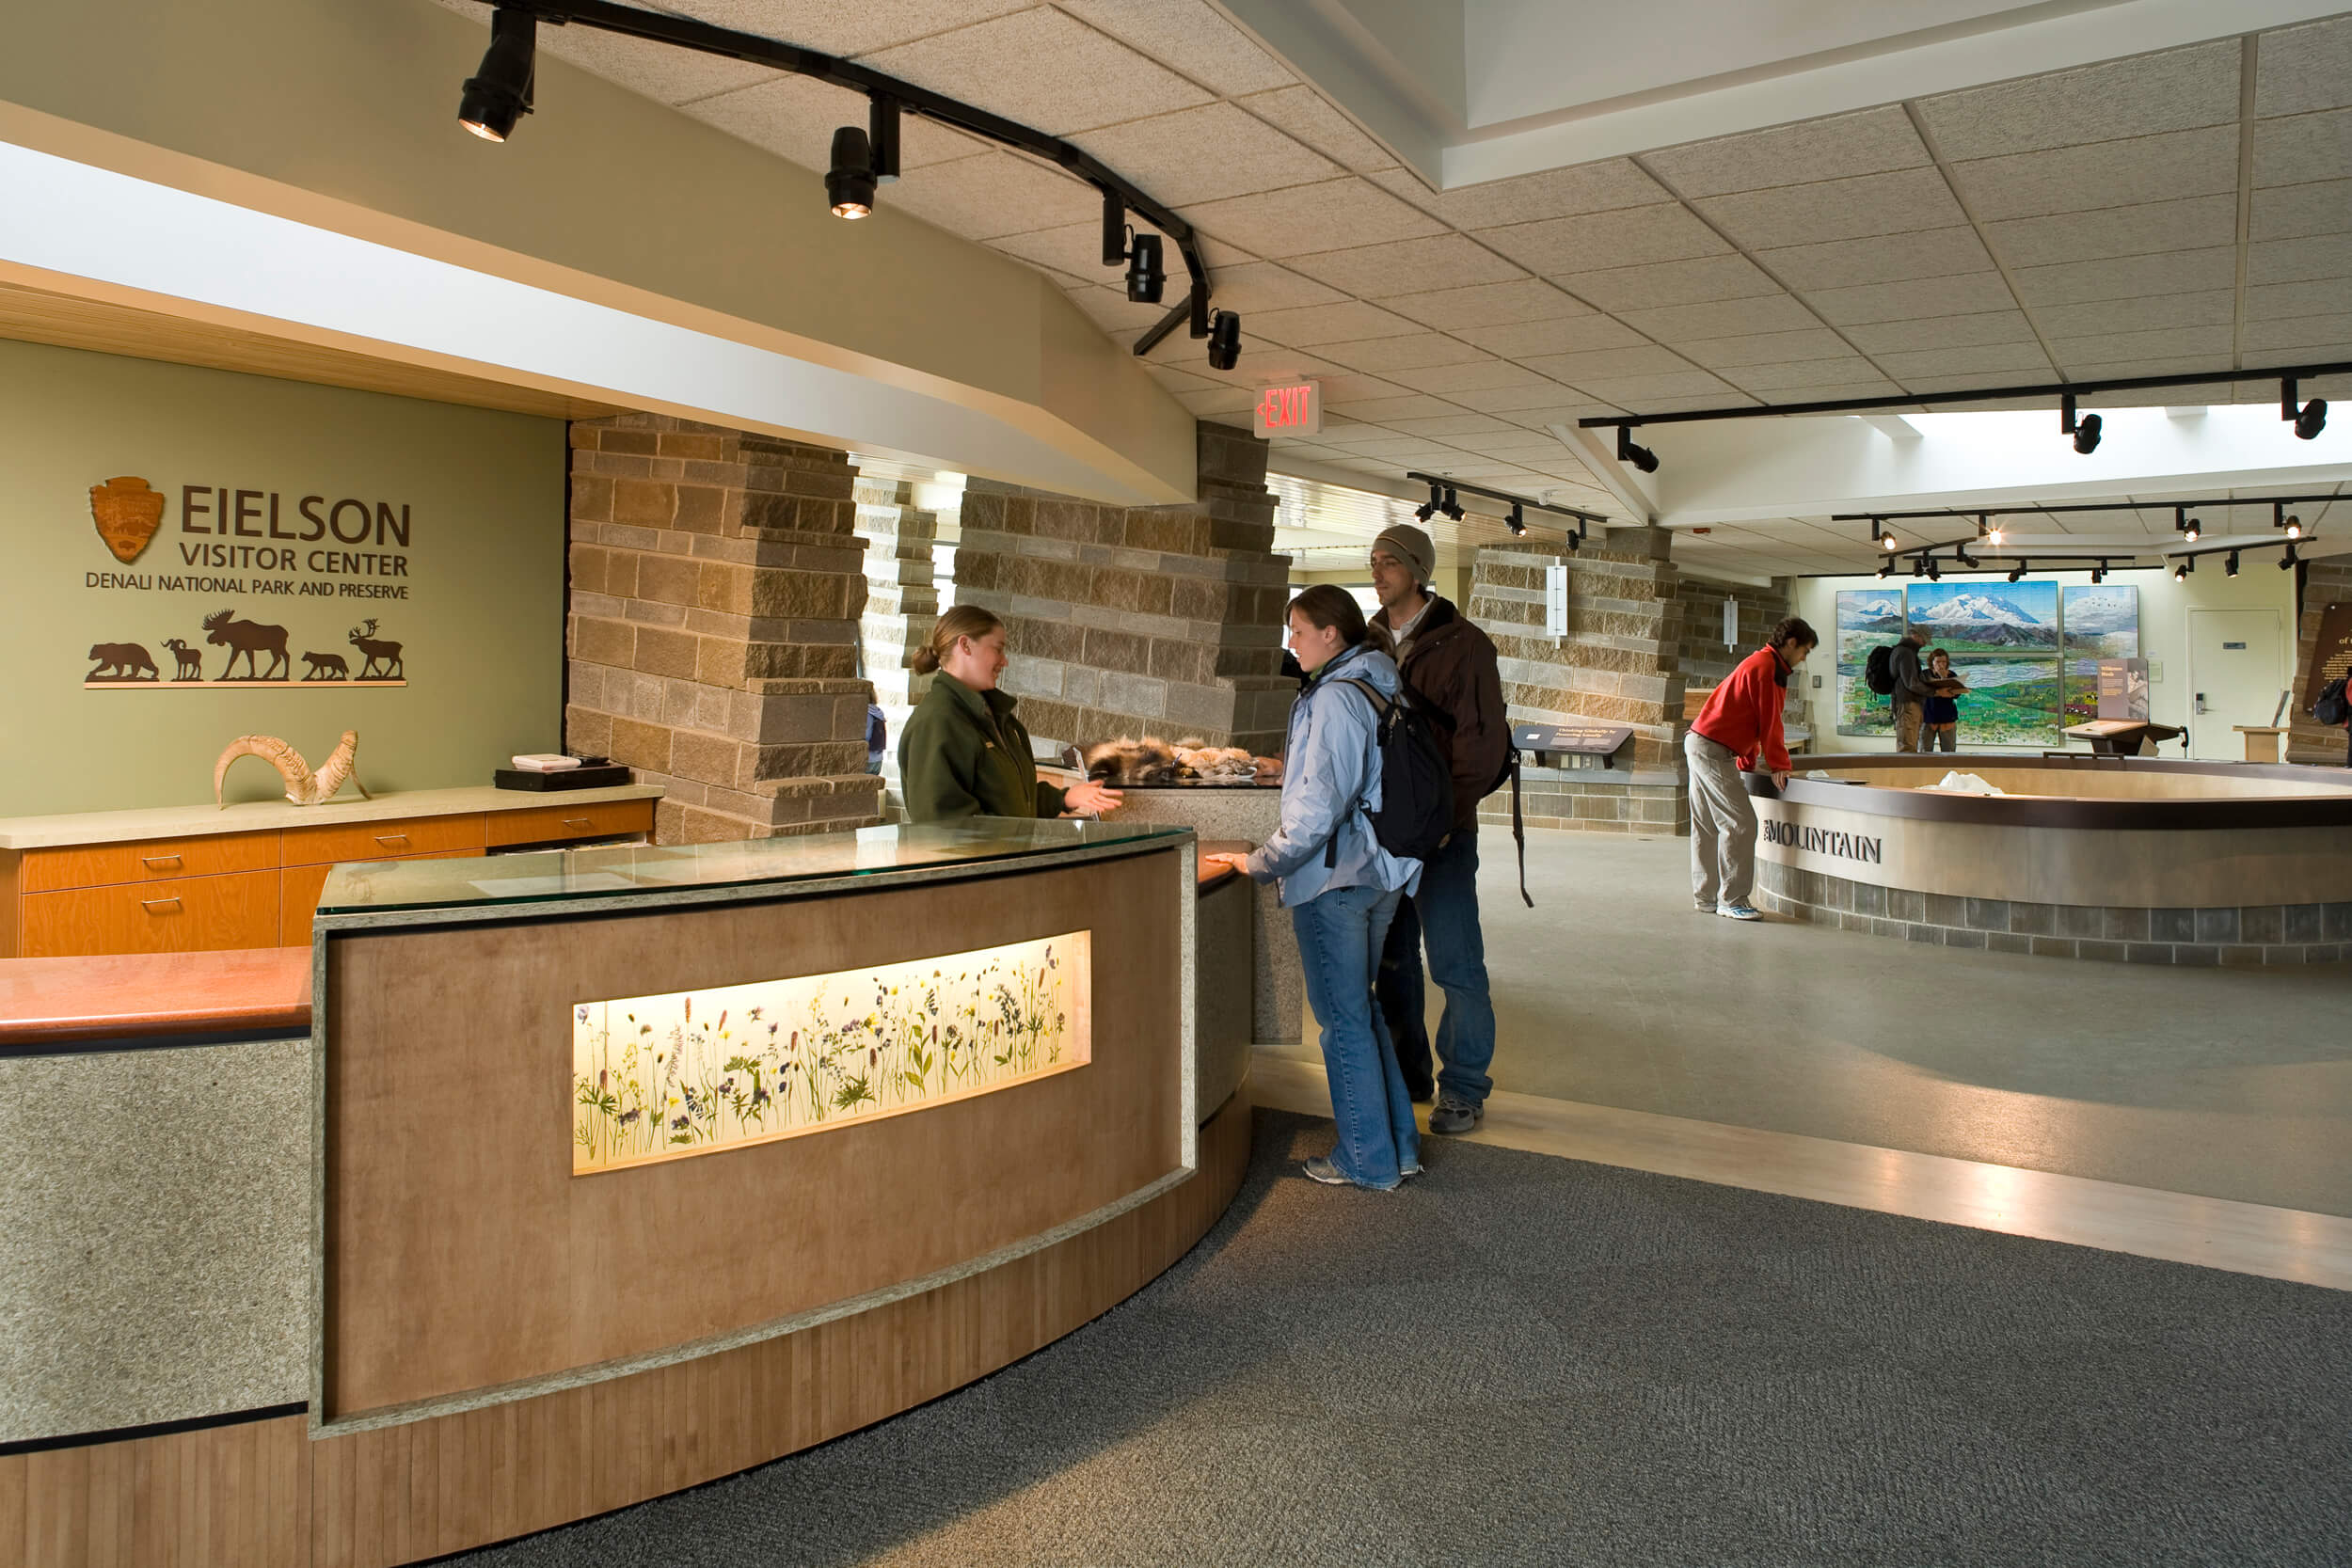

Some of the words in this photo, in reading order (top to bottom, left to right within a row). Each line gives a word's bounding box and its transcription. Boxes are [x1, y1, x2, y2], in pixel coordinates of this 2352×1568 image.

[1265, 386, 1311, 428] EXIT
[182, 484, 410, 547] EIELSON
[179, 542, 297, 571] VISITOR
[307, 550, 408, 577] CENTER
[86, 572, 151, 590] DENALI
[158, 575, 247, 594] NATIONAL
[252, 579, 294, 595] PARK
[299, 581, 334, 596] AND
[339, 583, 409, 600] PRESERVE
[1768, 819, 1882, 864] MOUNTAIN
